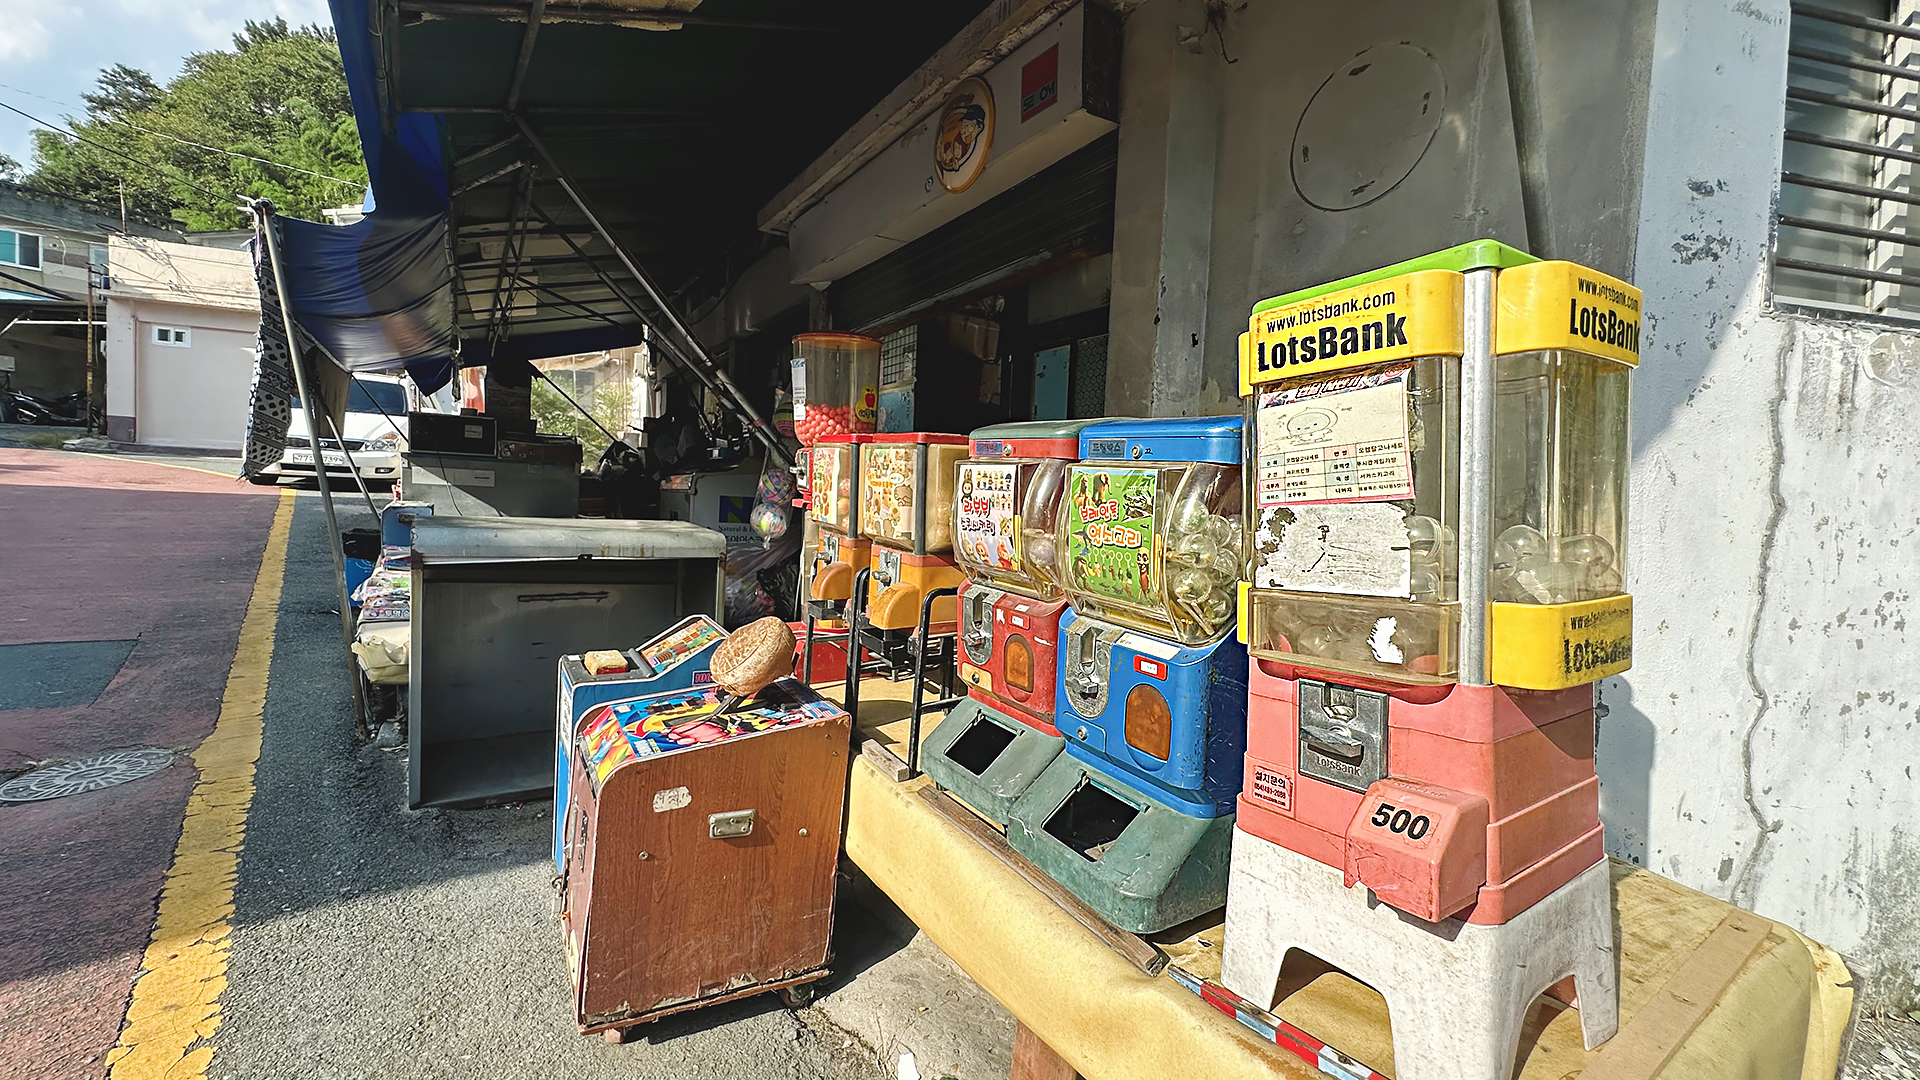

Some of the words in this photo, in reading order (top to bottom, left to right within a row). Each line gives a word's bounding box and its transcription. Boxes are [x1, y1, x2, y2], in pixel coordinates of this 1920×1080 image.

[1266, 291, 1396, 334] www.lotsbank.com
[1569, 297, 1640, 355] LotsBank
[1257, 312, 1408, 373] LotsBank
[1088, 524, 1140, 546] 열쇠고리
[1254, 770, 1286, 789] 설치문의
[1370, 802, 1431, 840] 500
